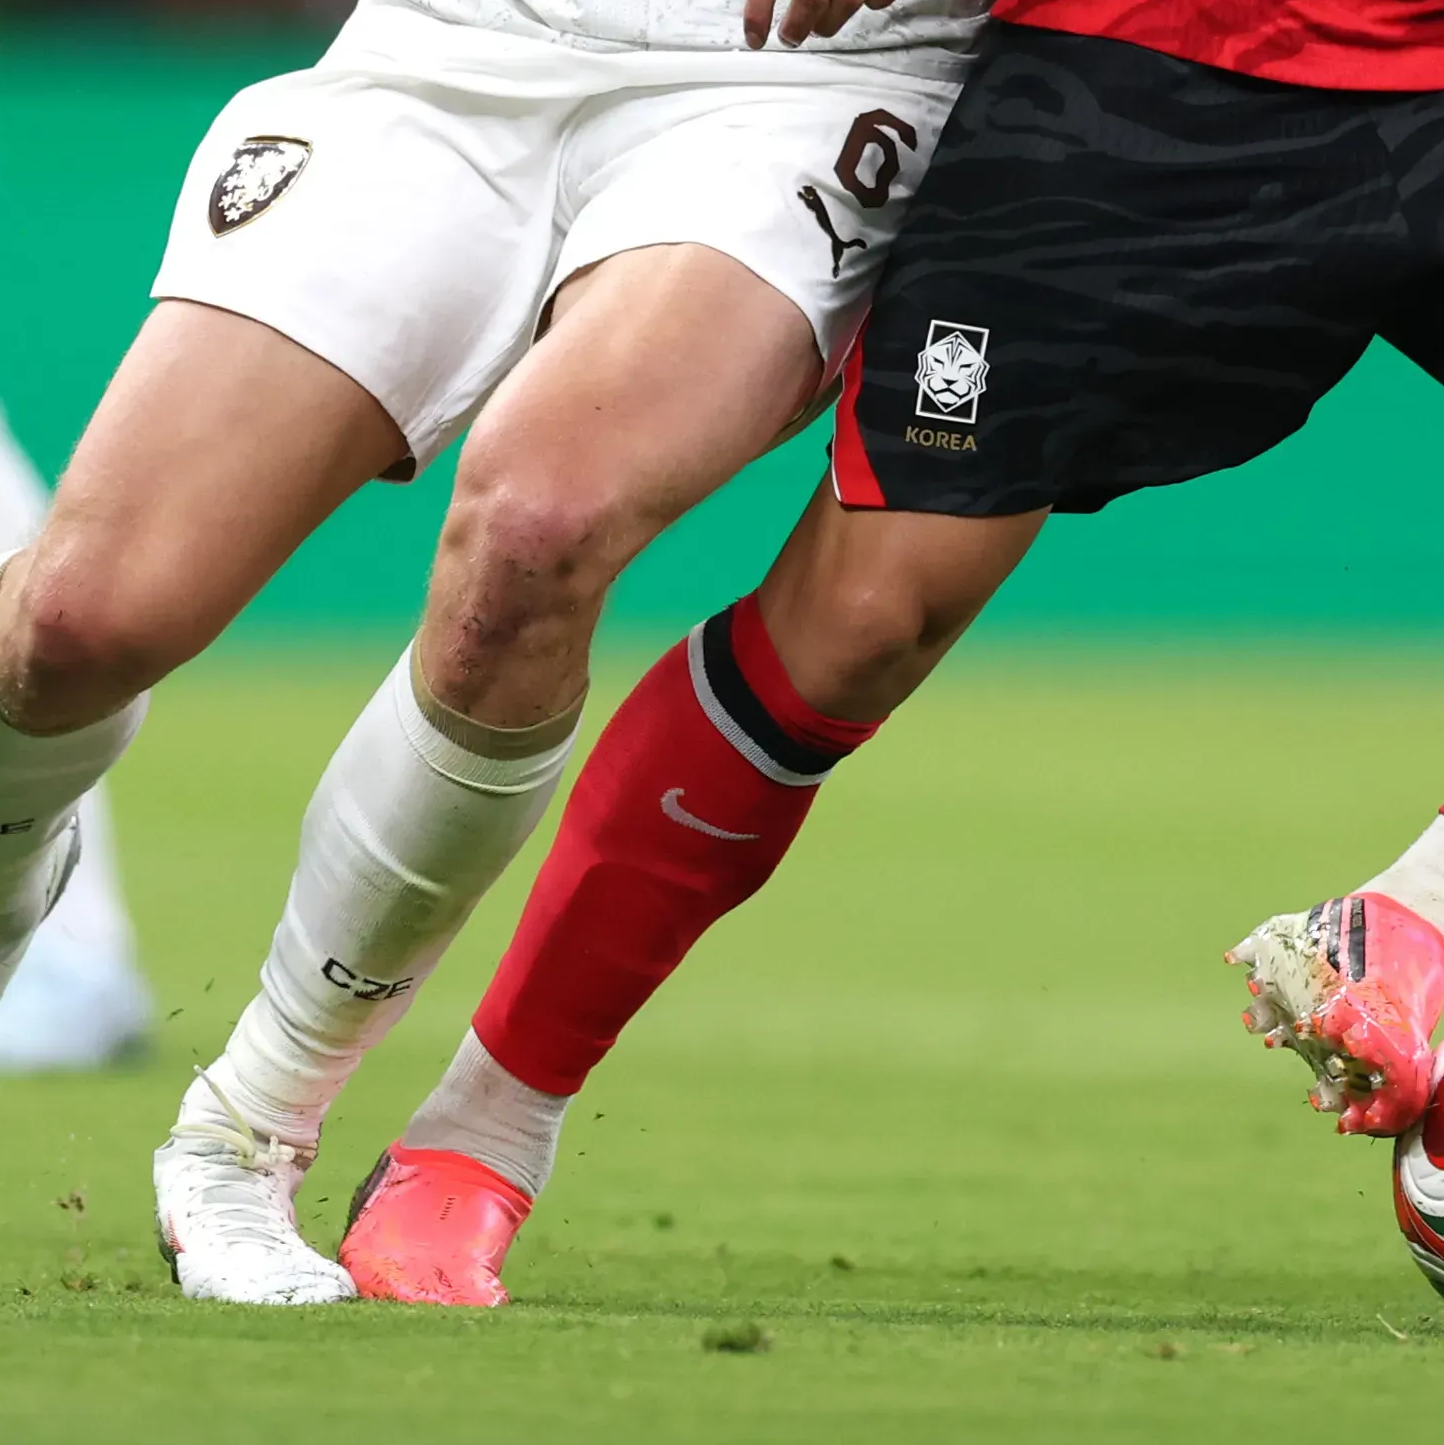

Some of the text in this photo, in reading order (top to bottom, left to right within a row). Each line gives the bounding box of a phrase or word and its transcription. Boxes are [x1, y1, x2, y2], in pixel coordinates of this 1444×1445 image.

[834, 108, 918, 209] 6
[905, 425, 978, 452] KOREA
[321, 957, 414, 1001] CZE
